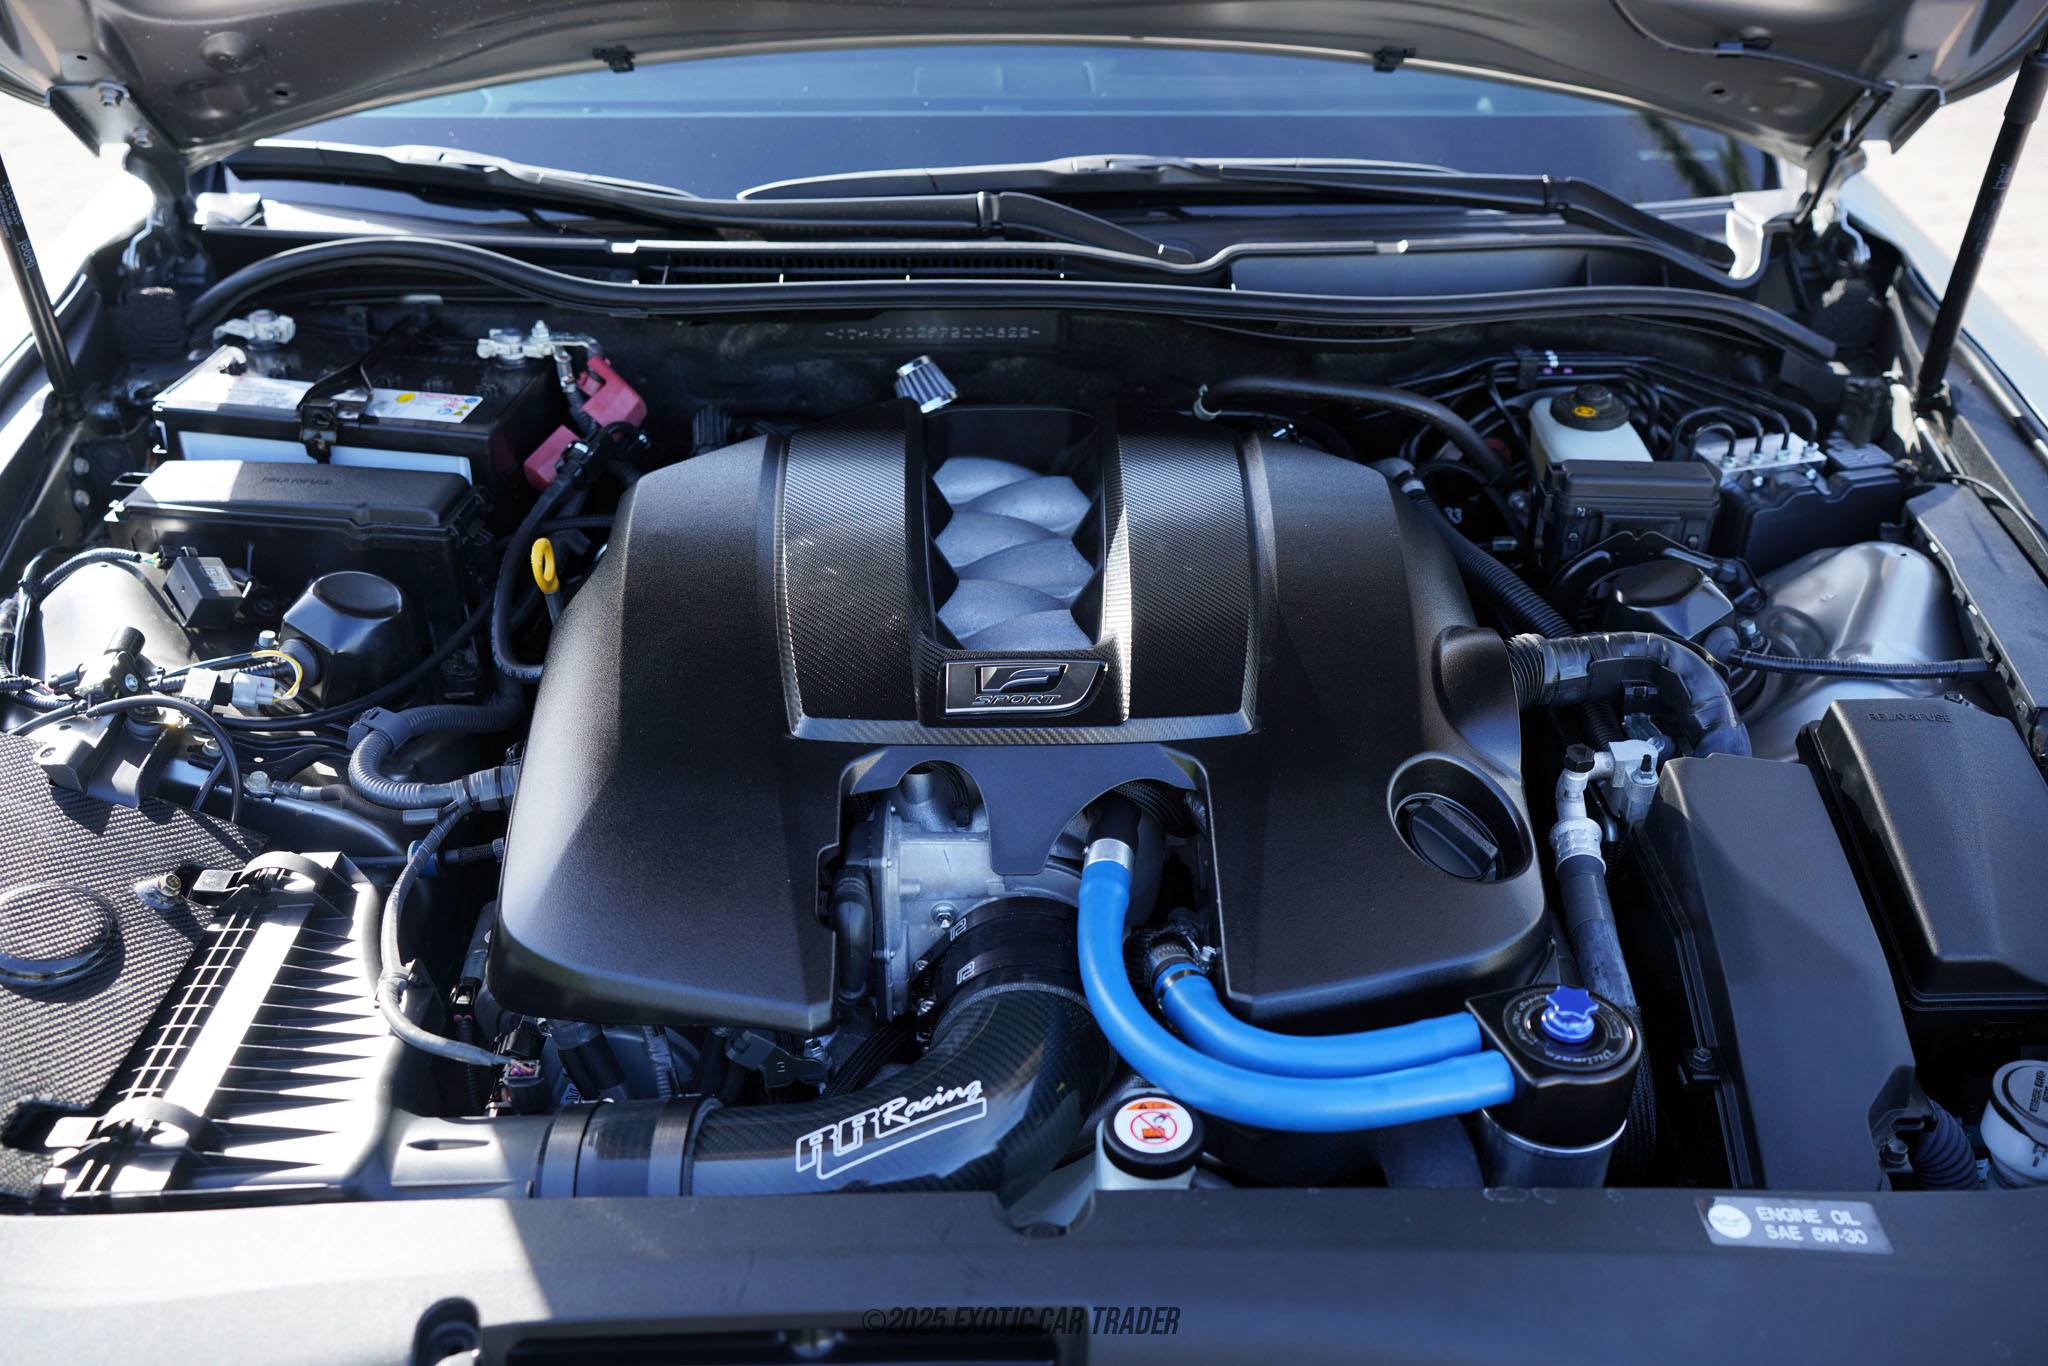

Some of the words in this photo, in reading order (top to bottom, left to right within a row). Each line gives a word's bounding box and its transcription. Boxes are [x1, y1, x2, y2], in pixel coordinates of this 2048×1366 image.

[972, 694, 1061, 706] SPORT
[1866, 712, 1953, 723] RELAY&FUSE
[879, 1080, 983, 1127] Racing
[1755, 1206, 1823, 1224] ENGINE
[1830, 1209, 1862, 1226] OIL
[1765, 1225, 1805, 1242] SAE
[1811, 1226, 1869, 1245] 5W-30
